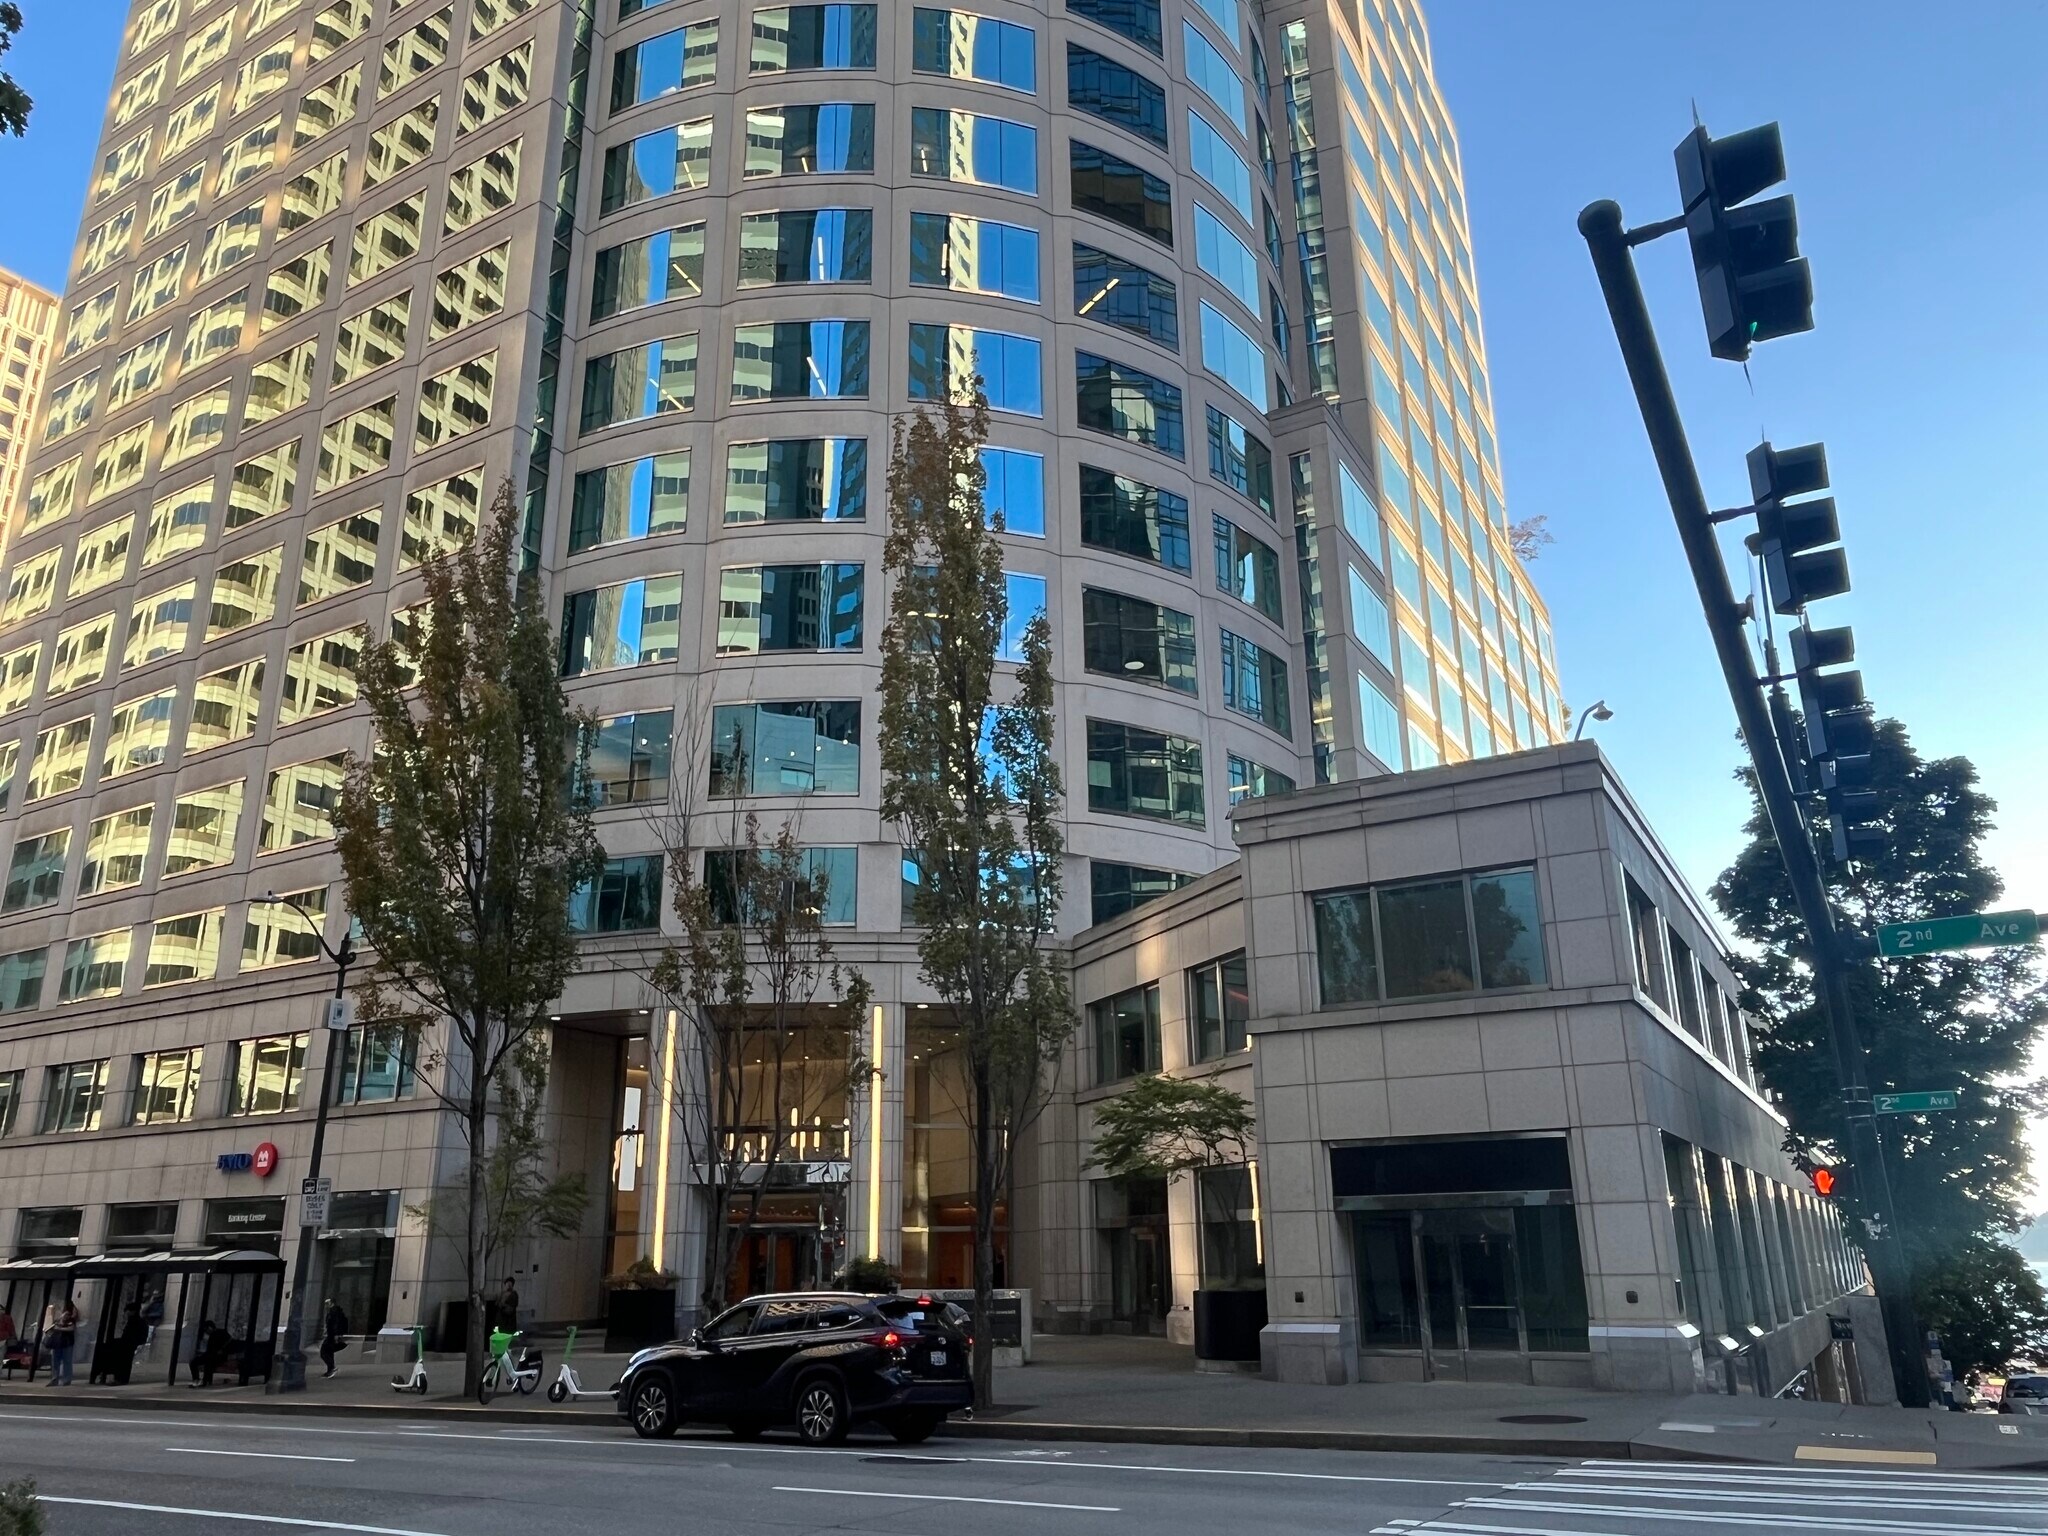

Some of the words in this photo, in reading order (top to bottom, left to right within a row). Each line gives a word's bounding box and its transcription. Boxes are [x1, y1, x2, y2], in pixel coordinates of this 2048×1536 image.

[1896, 927, 1933, 948] 2nd
[1980, 922, 2020, 939] Ave
[1930, 1096, 1949, 1106] Ave
